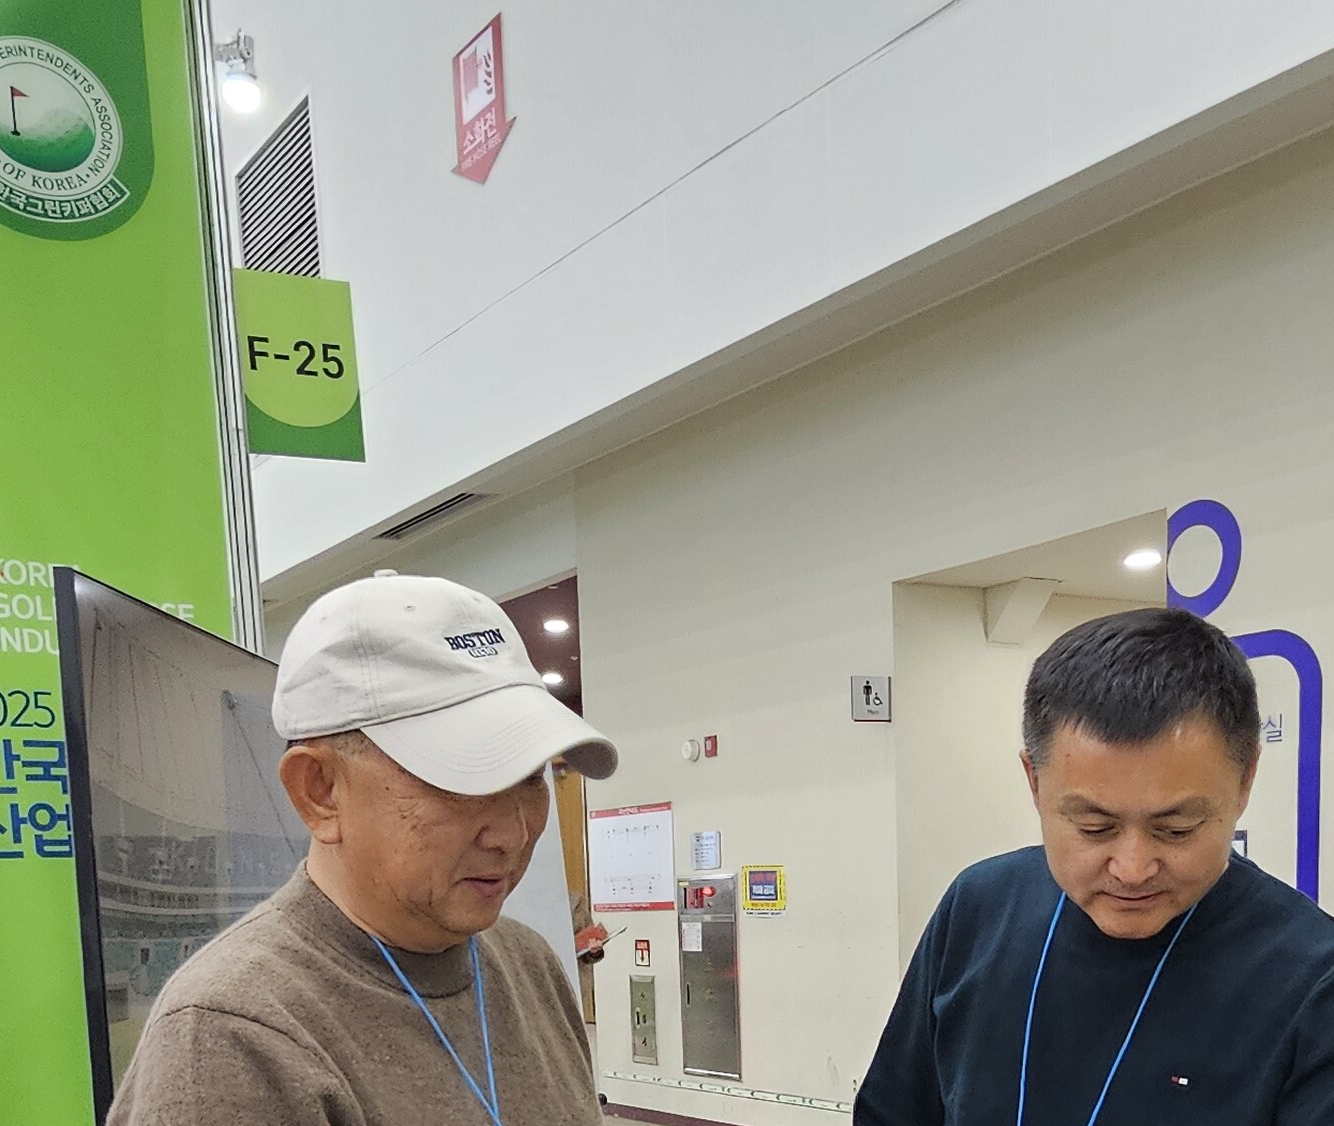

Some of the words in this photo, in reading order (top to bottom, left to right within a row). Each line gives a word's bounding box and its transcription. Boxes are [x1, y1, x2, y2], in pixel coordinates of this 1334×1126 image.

[88, 96, 114, 177] ASSOCIATION
[462, 105, 498, 156] 소화전
[2, 161, 27, 180] OF
[31, 173, 88, 191] KOREA
[247, 335, 345, 379] F-25
[443, 628, 506, 651] BOSTON
[1260, 713, 1283, 743] 실
